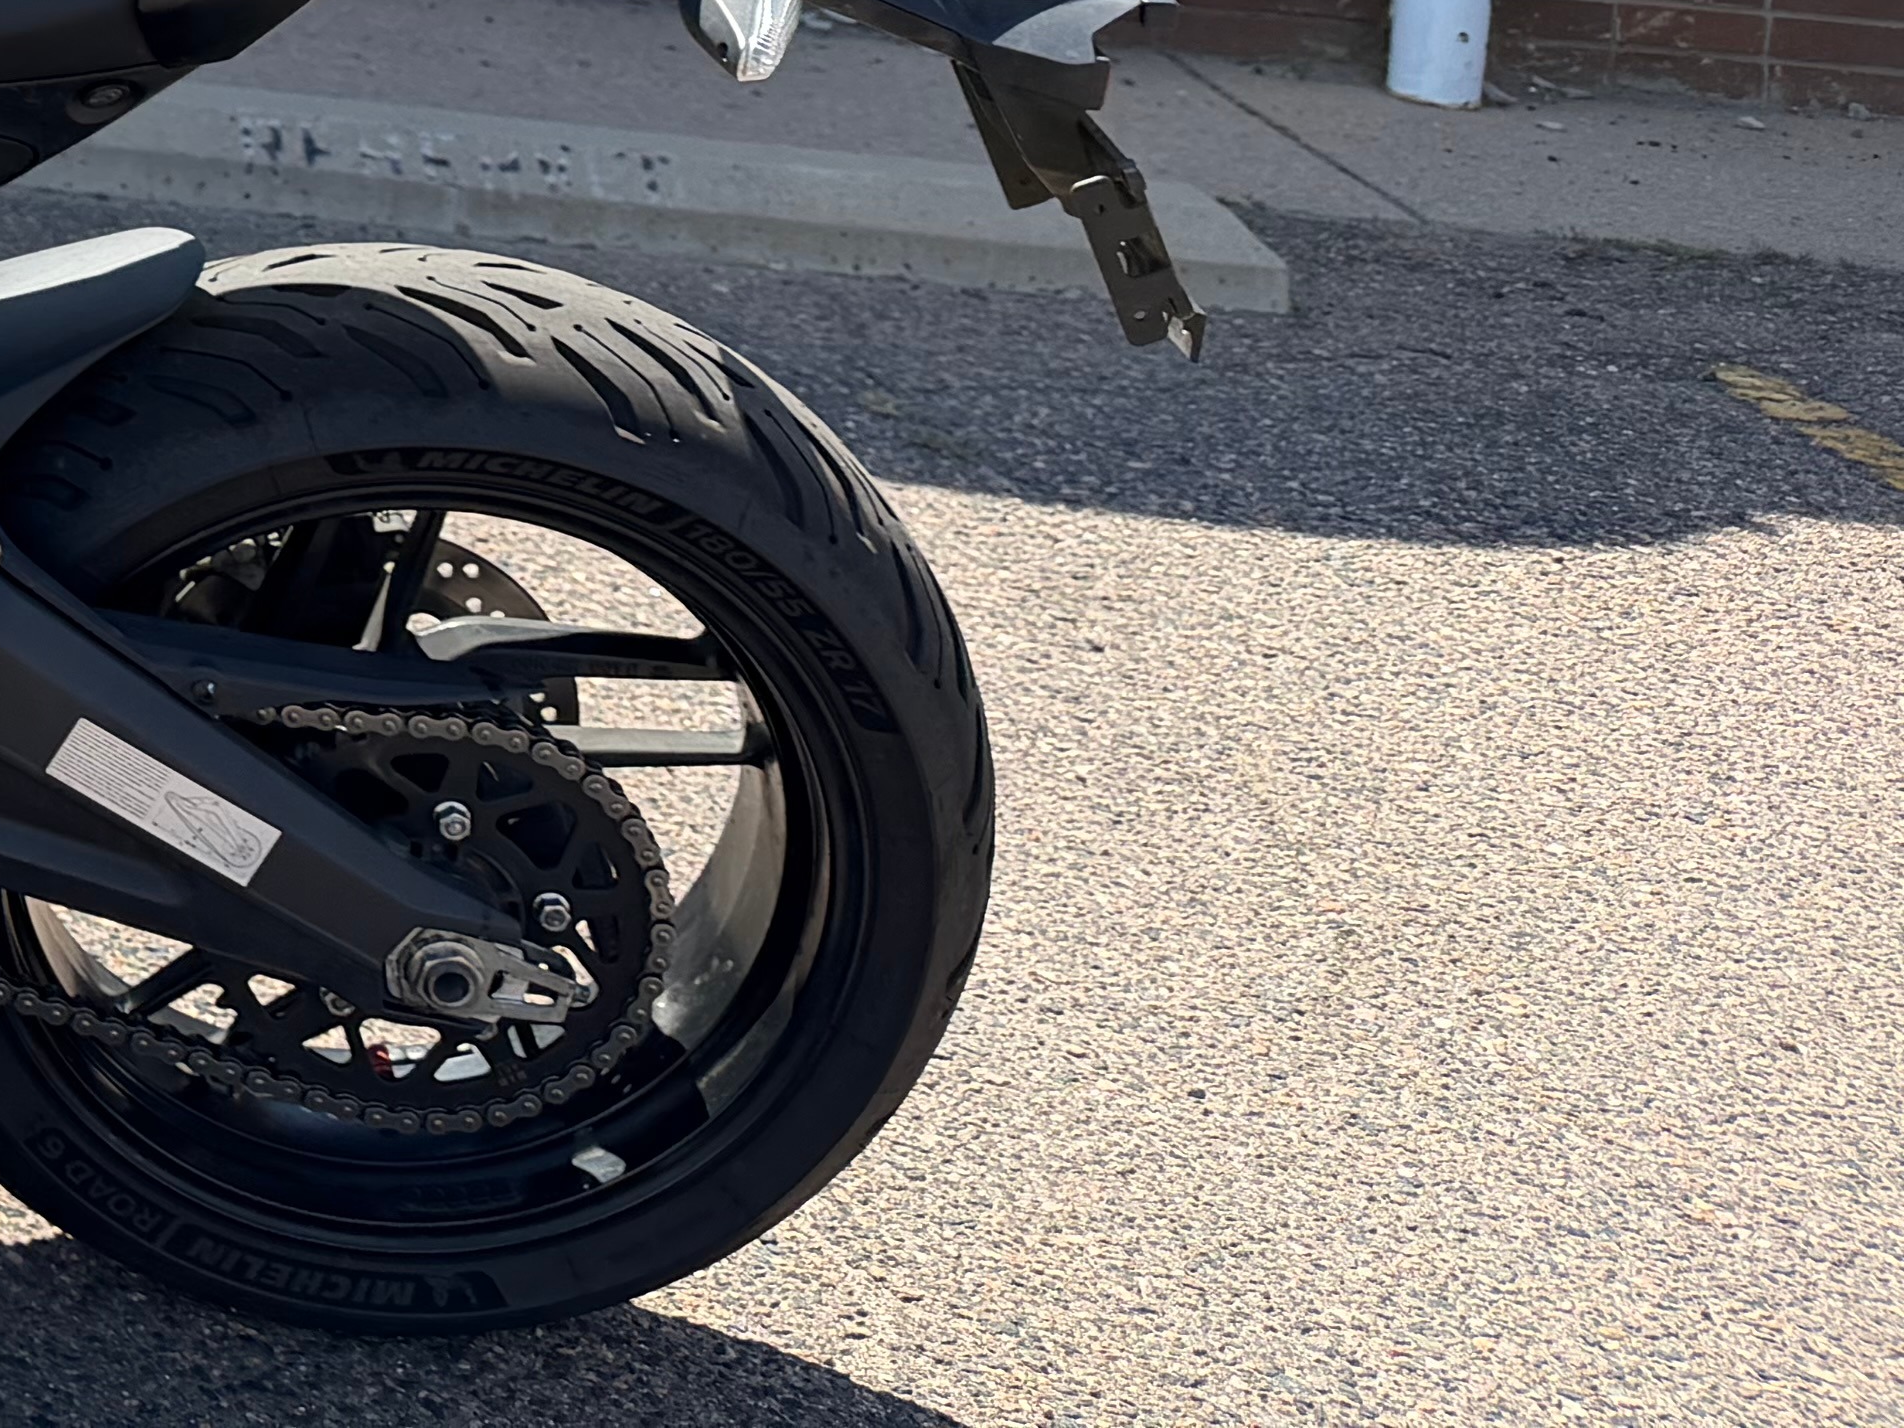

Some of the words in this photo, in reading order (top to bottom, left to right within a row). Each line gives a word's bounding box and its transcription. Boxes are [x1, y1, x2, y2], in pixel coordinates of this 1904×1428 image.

[419, 450, 661, 512] MICHELIN
[63, 1160, 164, 1234] ROAD
[186, 1237, 416, 1307] MICHELIN
